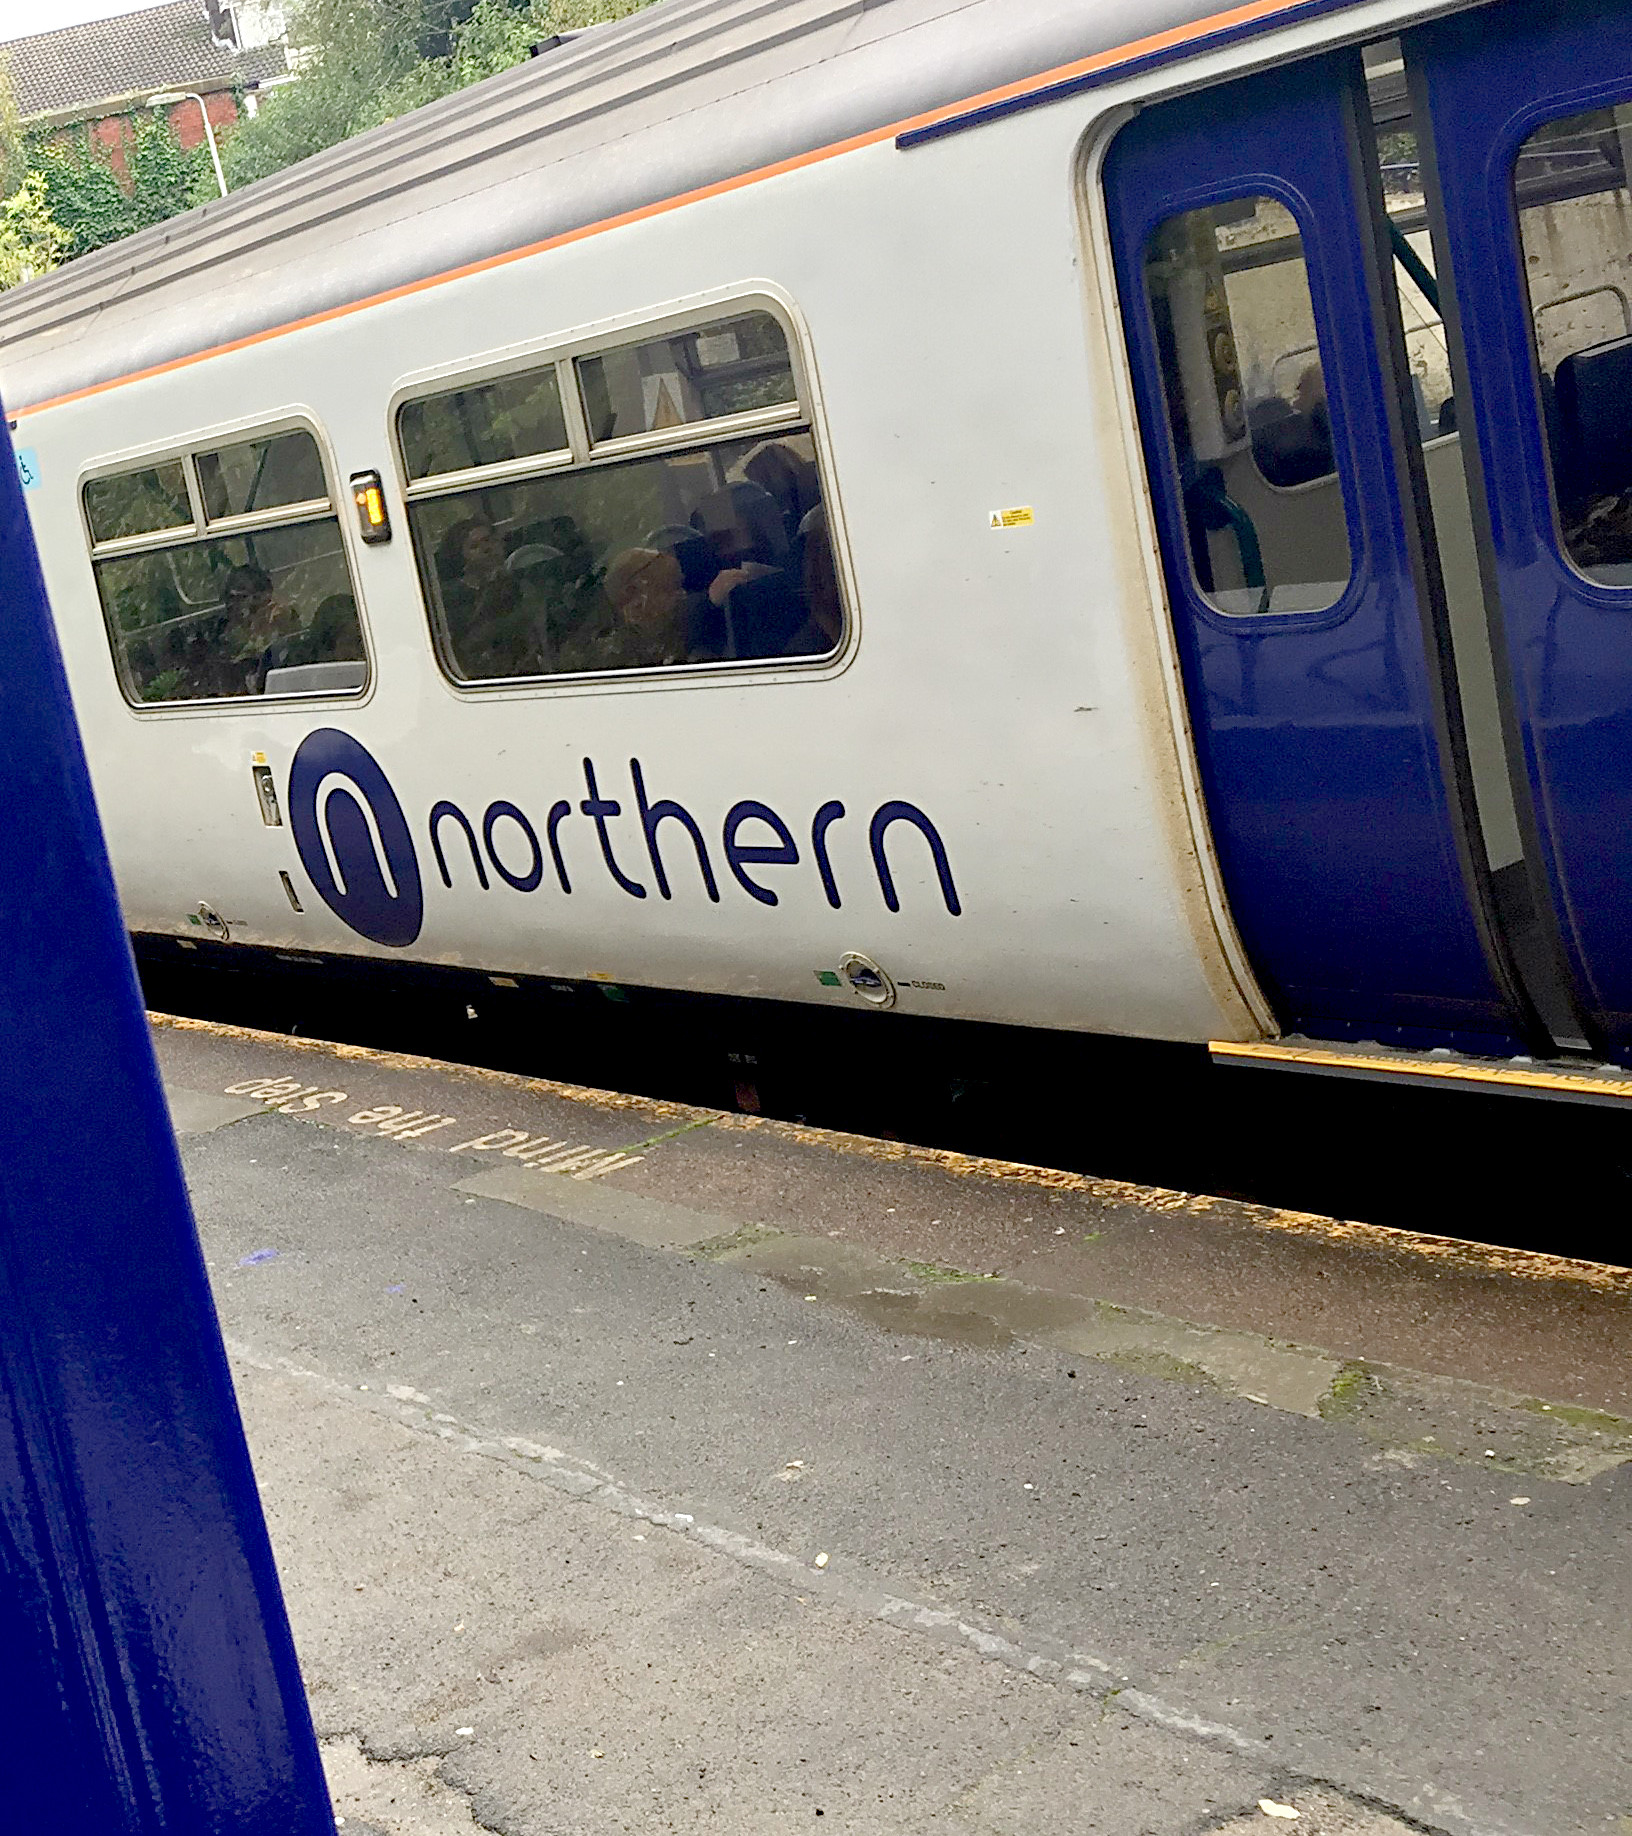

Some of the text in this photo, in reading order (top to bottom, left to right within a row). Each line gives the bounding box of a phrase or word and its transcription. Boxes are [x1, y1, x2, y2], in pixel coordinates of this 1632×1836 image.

[429, 757, 962, 917] northern
[224, 1075, 645, 1180] Mind the Step
